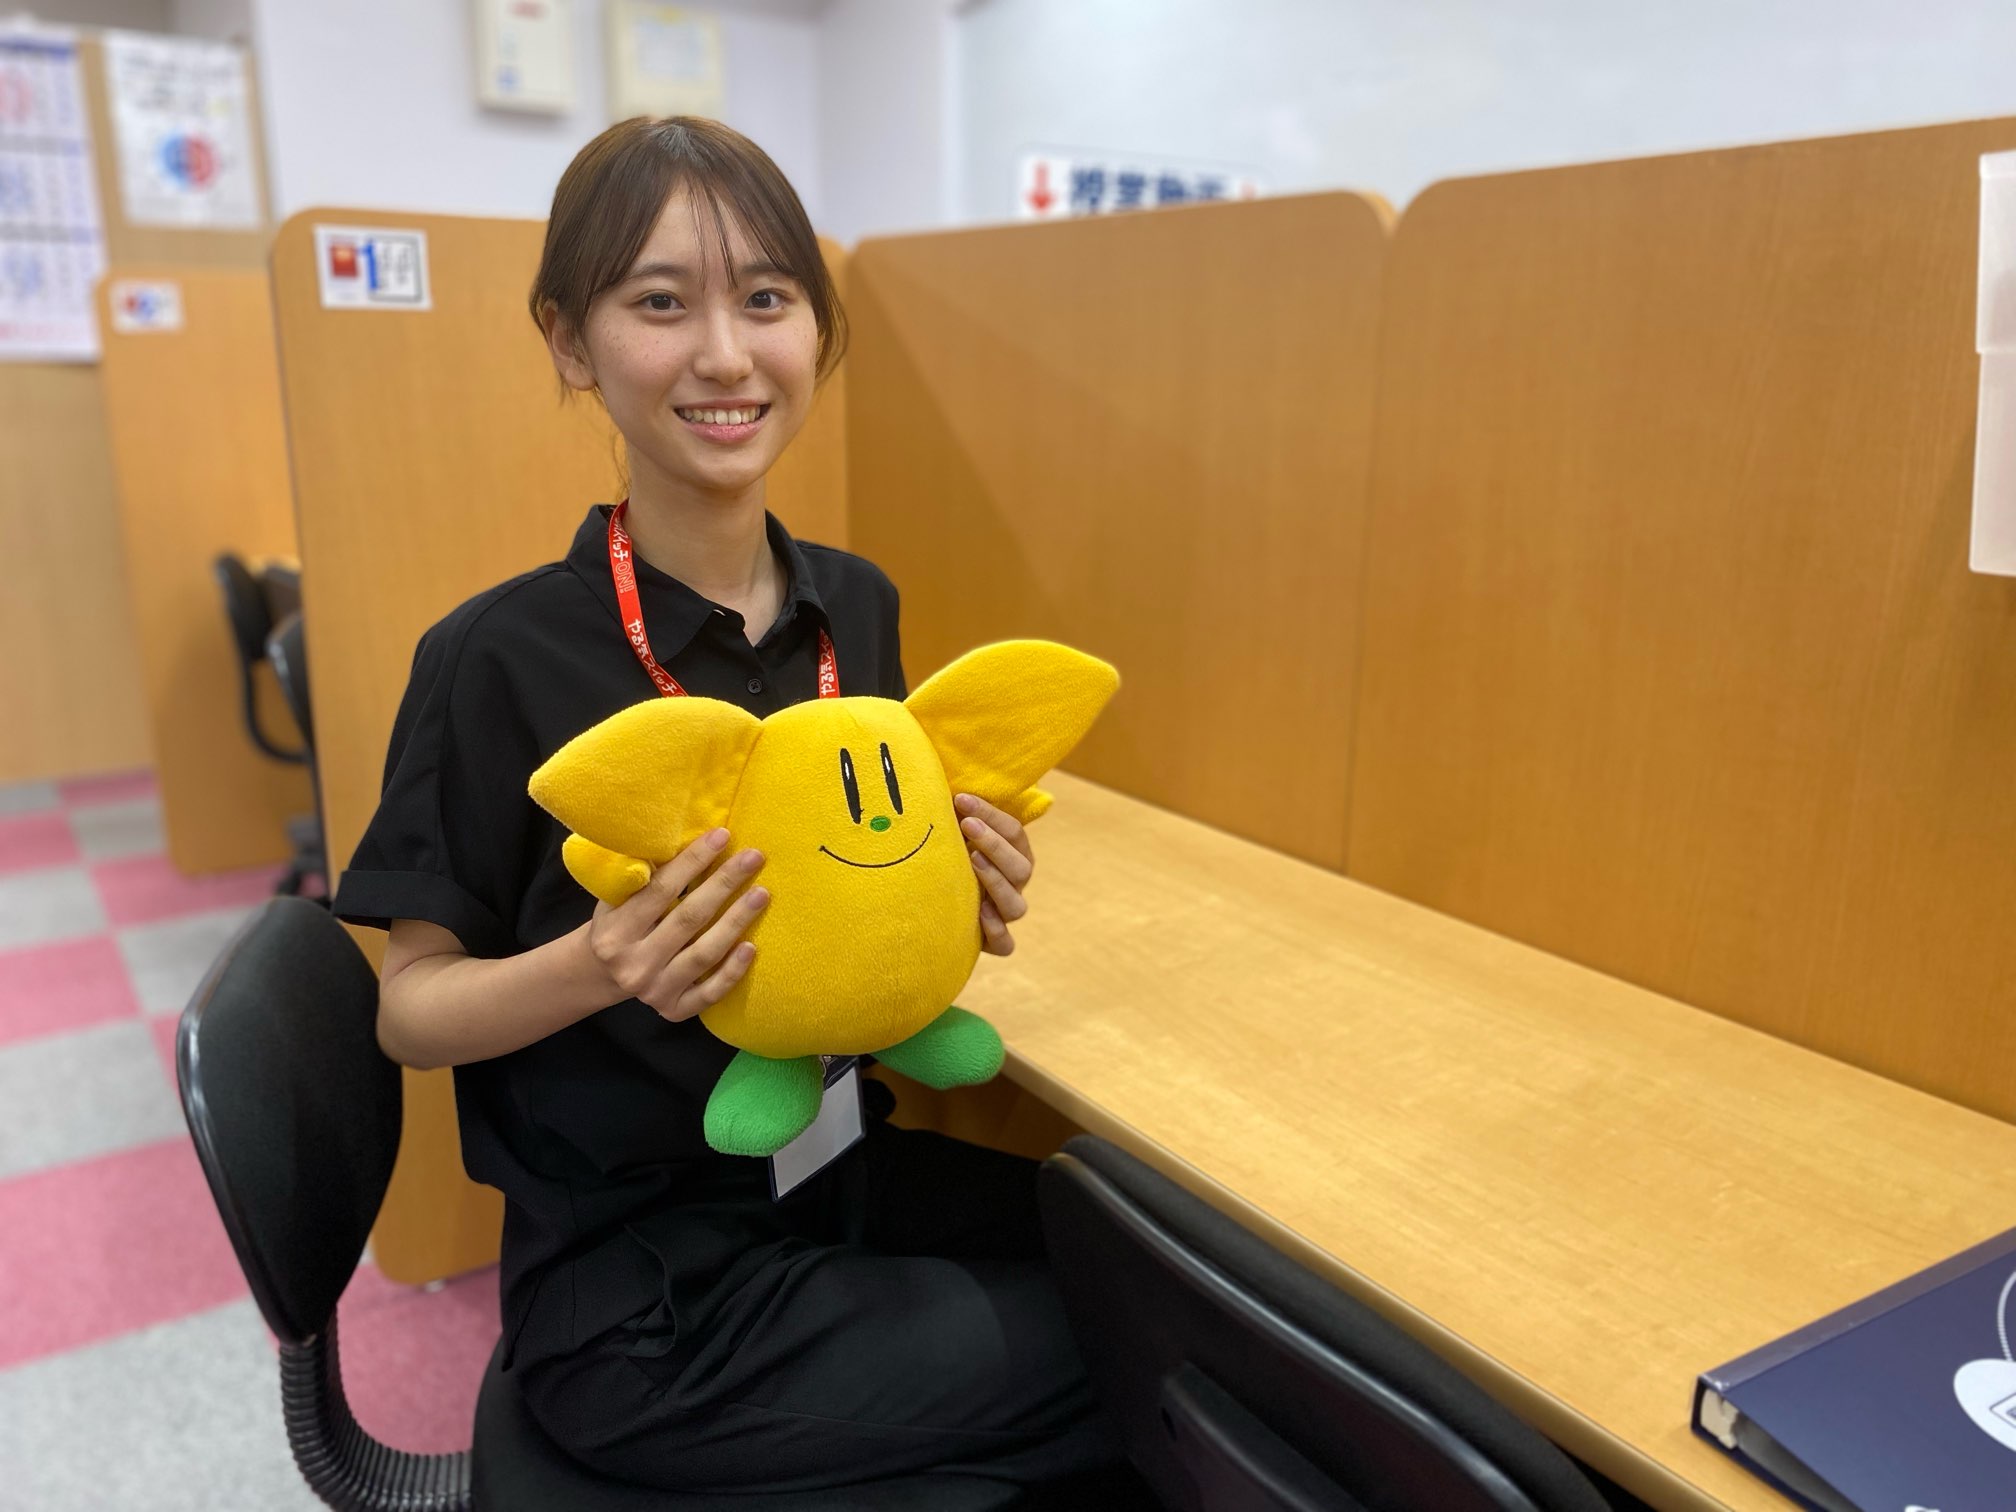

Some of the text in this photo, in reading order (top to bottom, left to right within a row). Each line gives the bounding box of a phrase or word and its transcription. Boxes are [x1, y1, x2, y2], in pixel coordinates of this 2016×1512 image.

[359, 240, 379, 290] 1
[627, 618, 686, 697] やる気スイッチ
